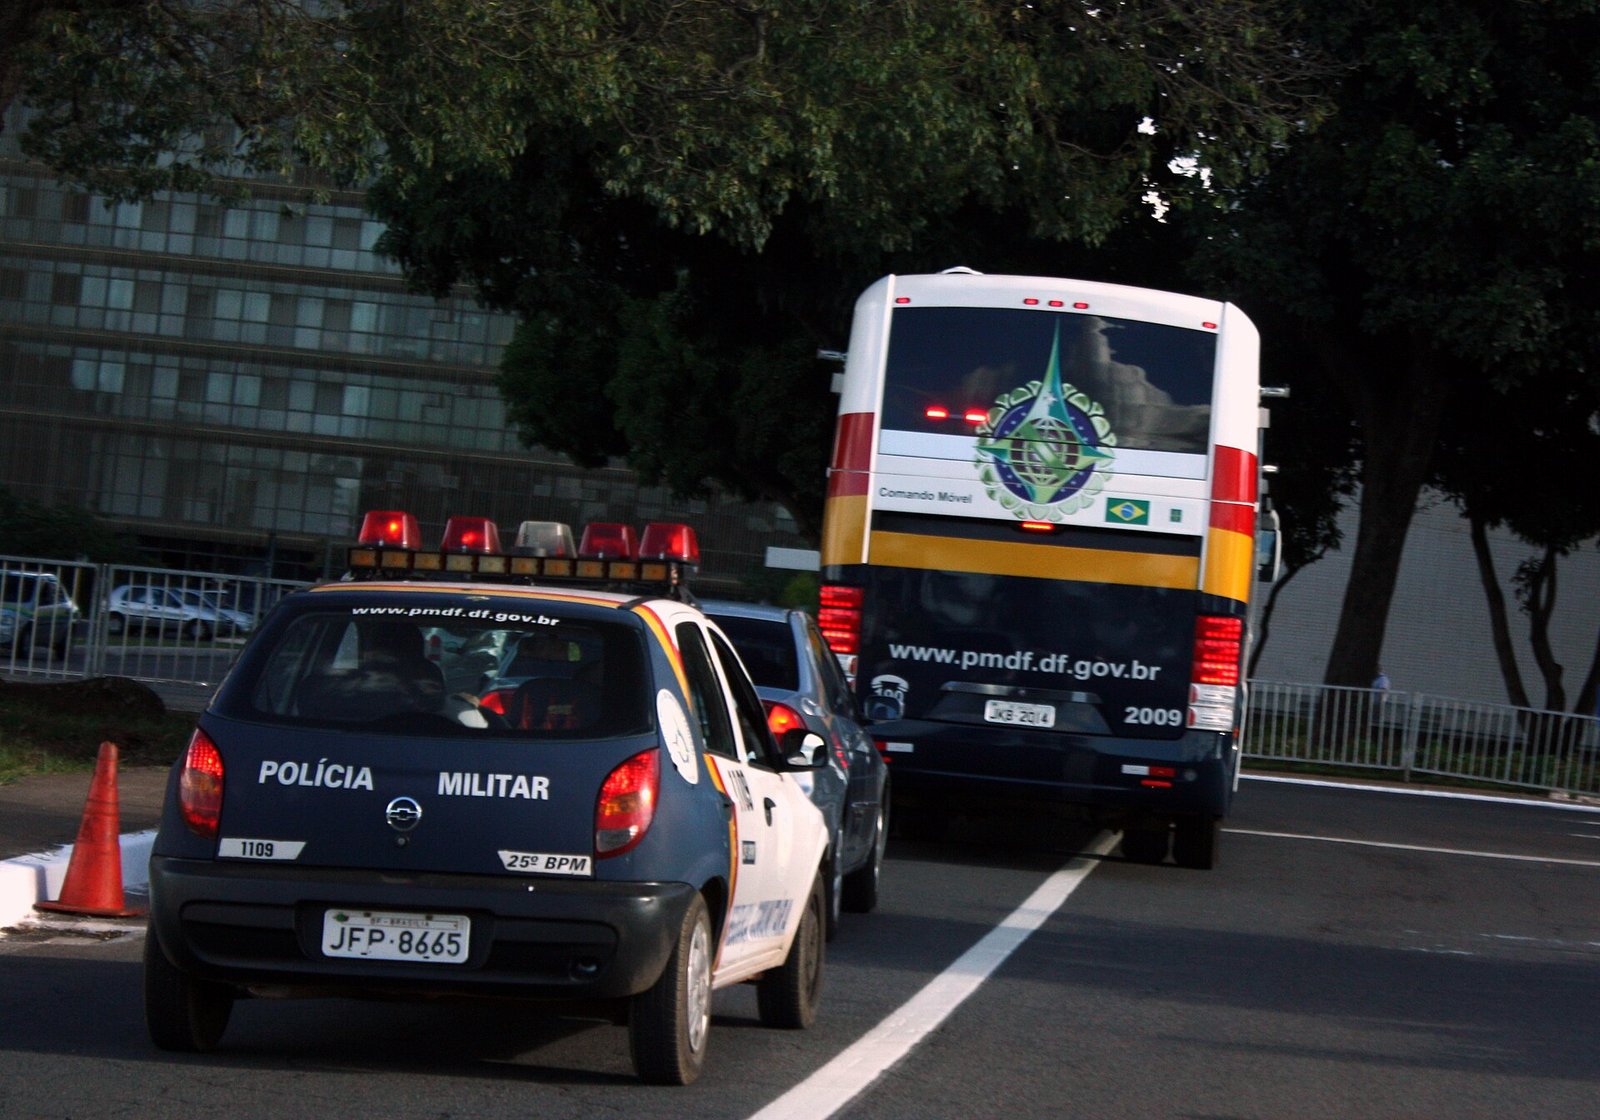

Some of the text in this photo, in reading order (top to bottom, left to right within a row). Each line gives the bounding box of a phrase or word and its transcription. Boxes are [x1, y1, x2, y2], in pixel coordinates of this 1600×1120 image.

[879, 487, 973, 504] Comando Móvel
[352, 606, 560, 627] www.pmdf.df.gov.br
[888, 643, 1162, 681] www.pmdf.df.gov.br
[1123, 706, 1183, 727] 2009
[258, 758, 550, 800] POLÍCIA MILITAR
[241, 841, 274, 858] 1109
[544, 856, 587, 872] BPM
